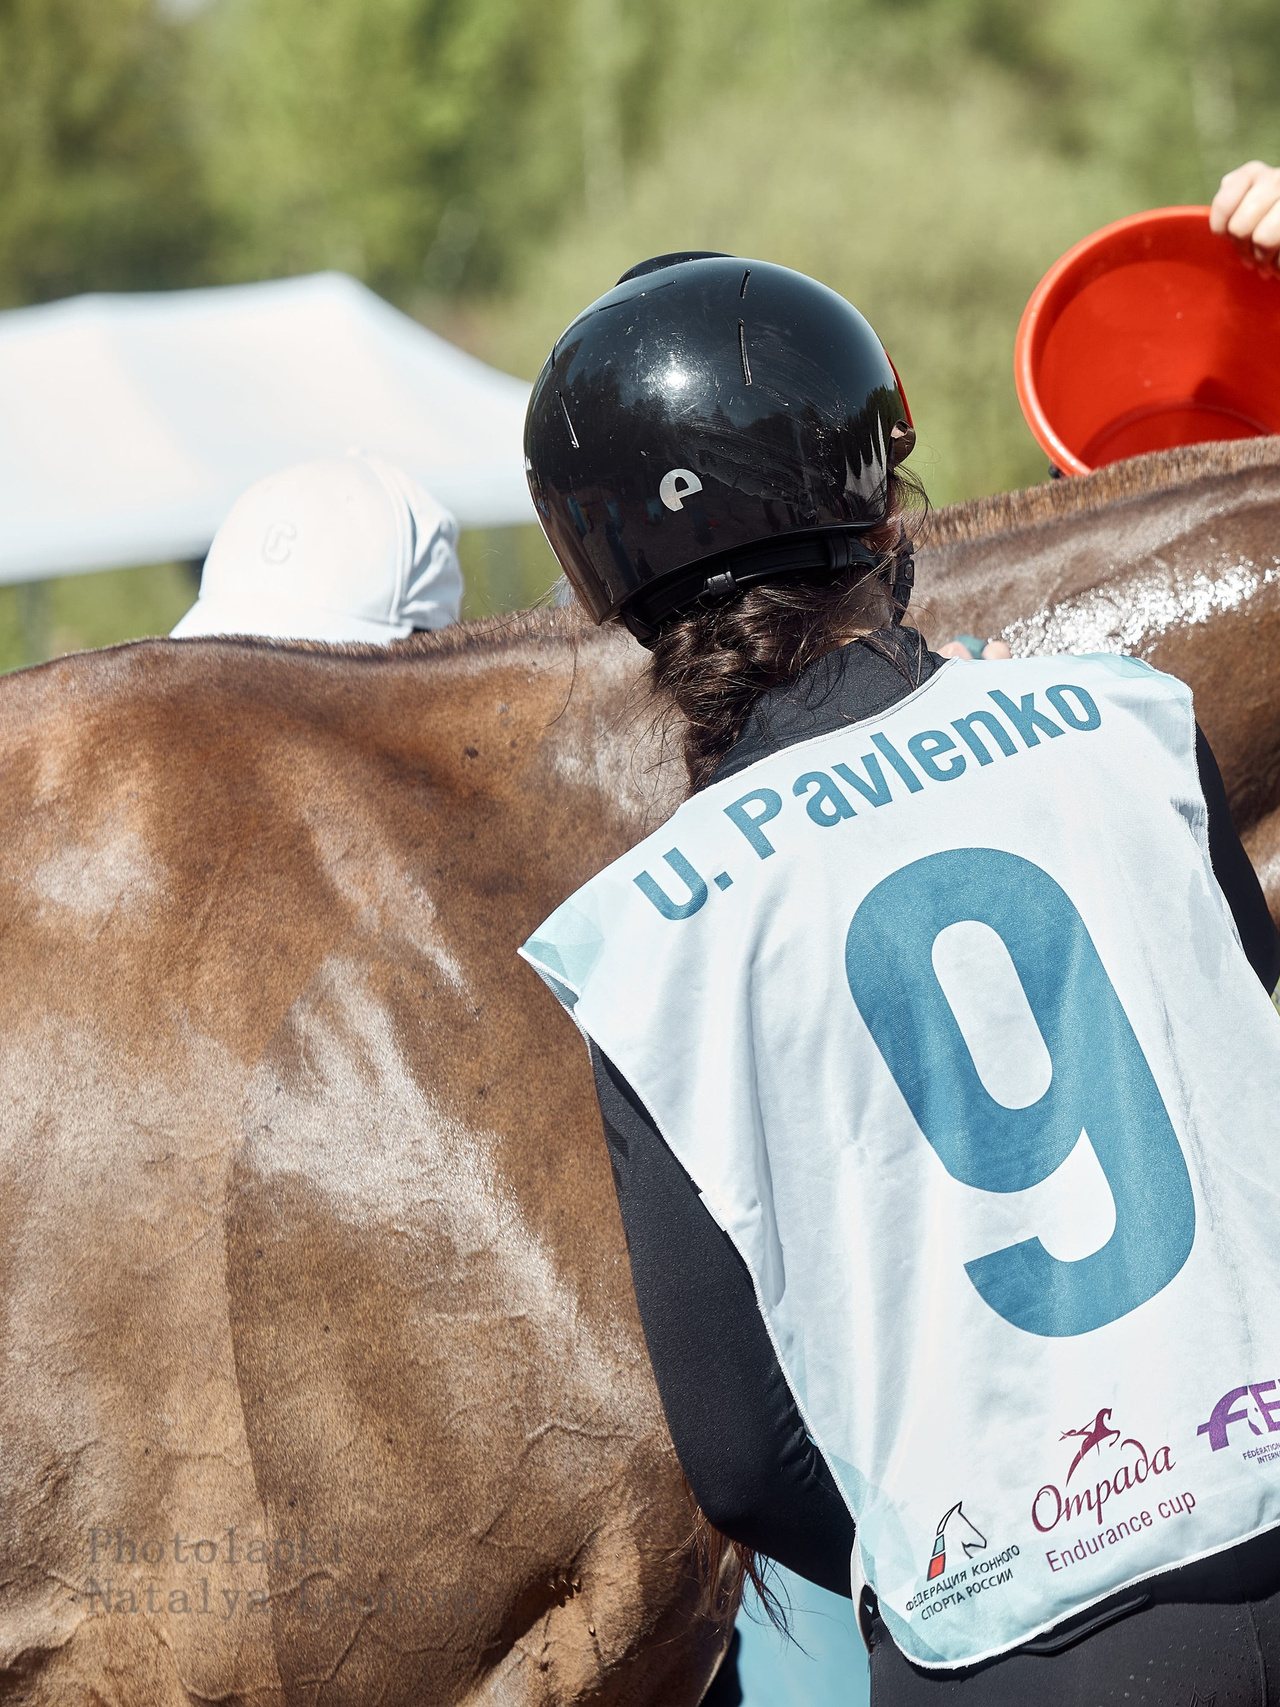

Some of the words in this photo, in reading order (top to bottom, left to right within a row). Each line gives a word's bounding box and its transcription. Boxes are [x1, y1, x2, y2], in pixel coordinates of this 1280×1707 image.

[632, 847, 734, 921] U.
[723, 684, 1102, 860] Pavlenko
[845, 847, 1195, 1338] 9
[1242, 1442, 1280, 1460] FÉDÉRATION
[1045, 1510, 1154, 1573] Endurance
[1157, 1489, 1197, 1521] cup
[905, 1570, 967, 1611] ФЕДЕРАЦИЯ
[972, 1545, 1020, 1577] КОННОГО
[921, 1591, 966, 1620] СПОРТА
[966, 1568, 1013, 1597] РОССИИ
